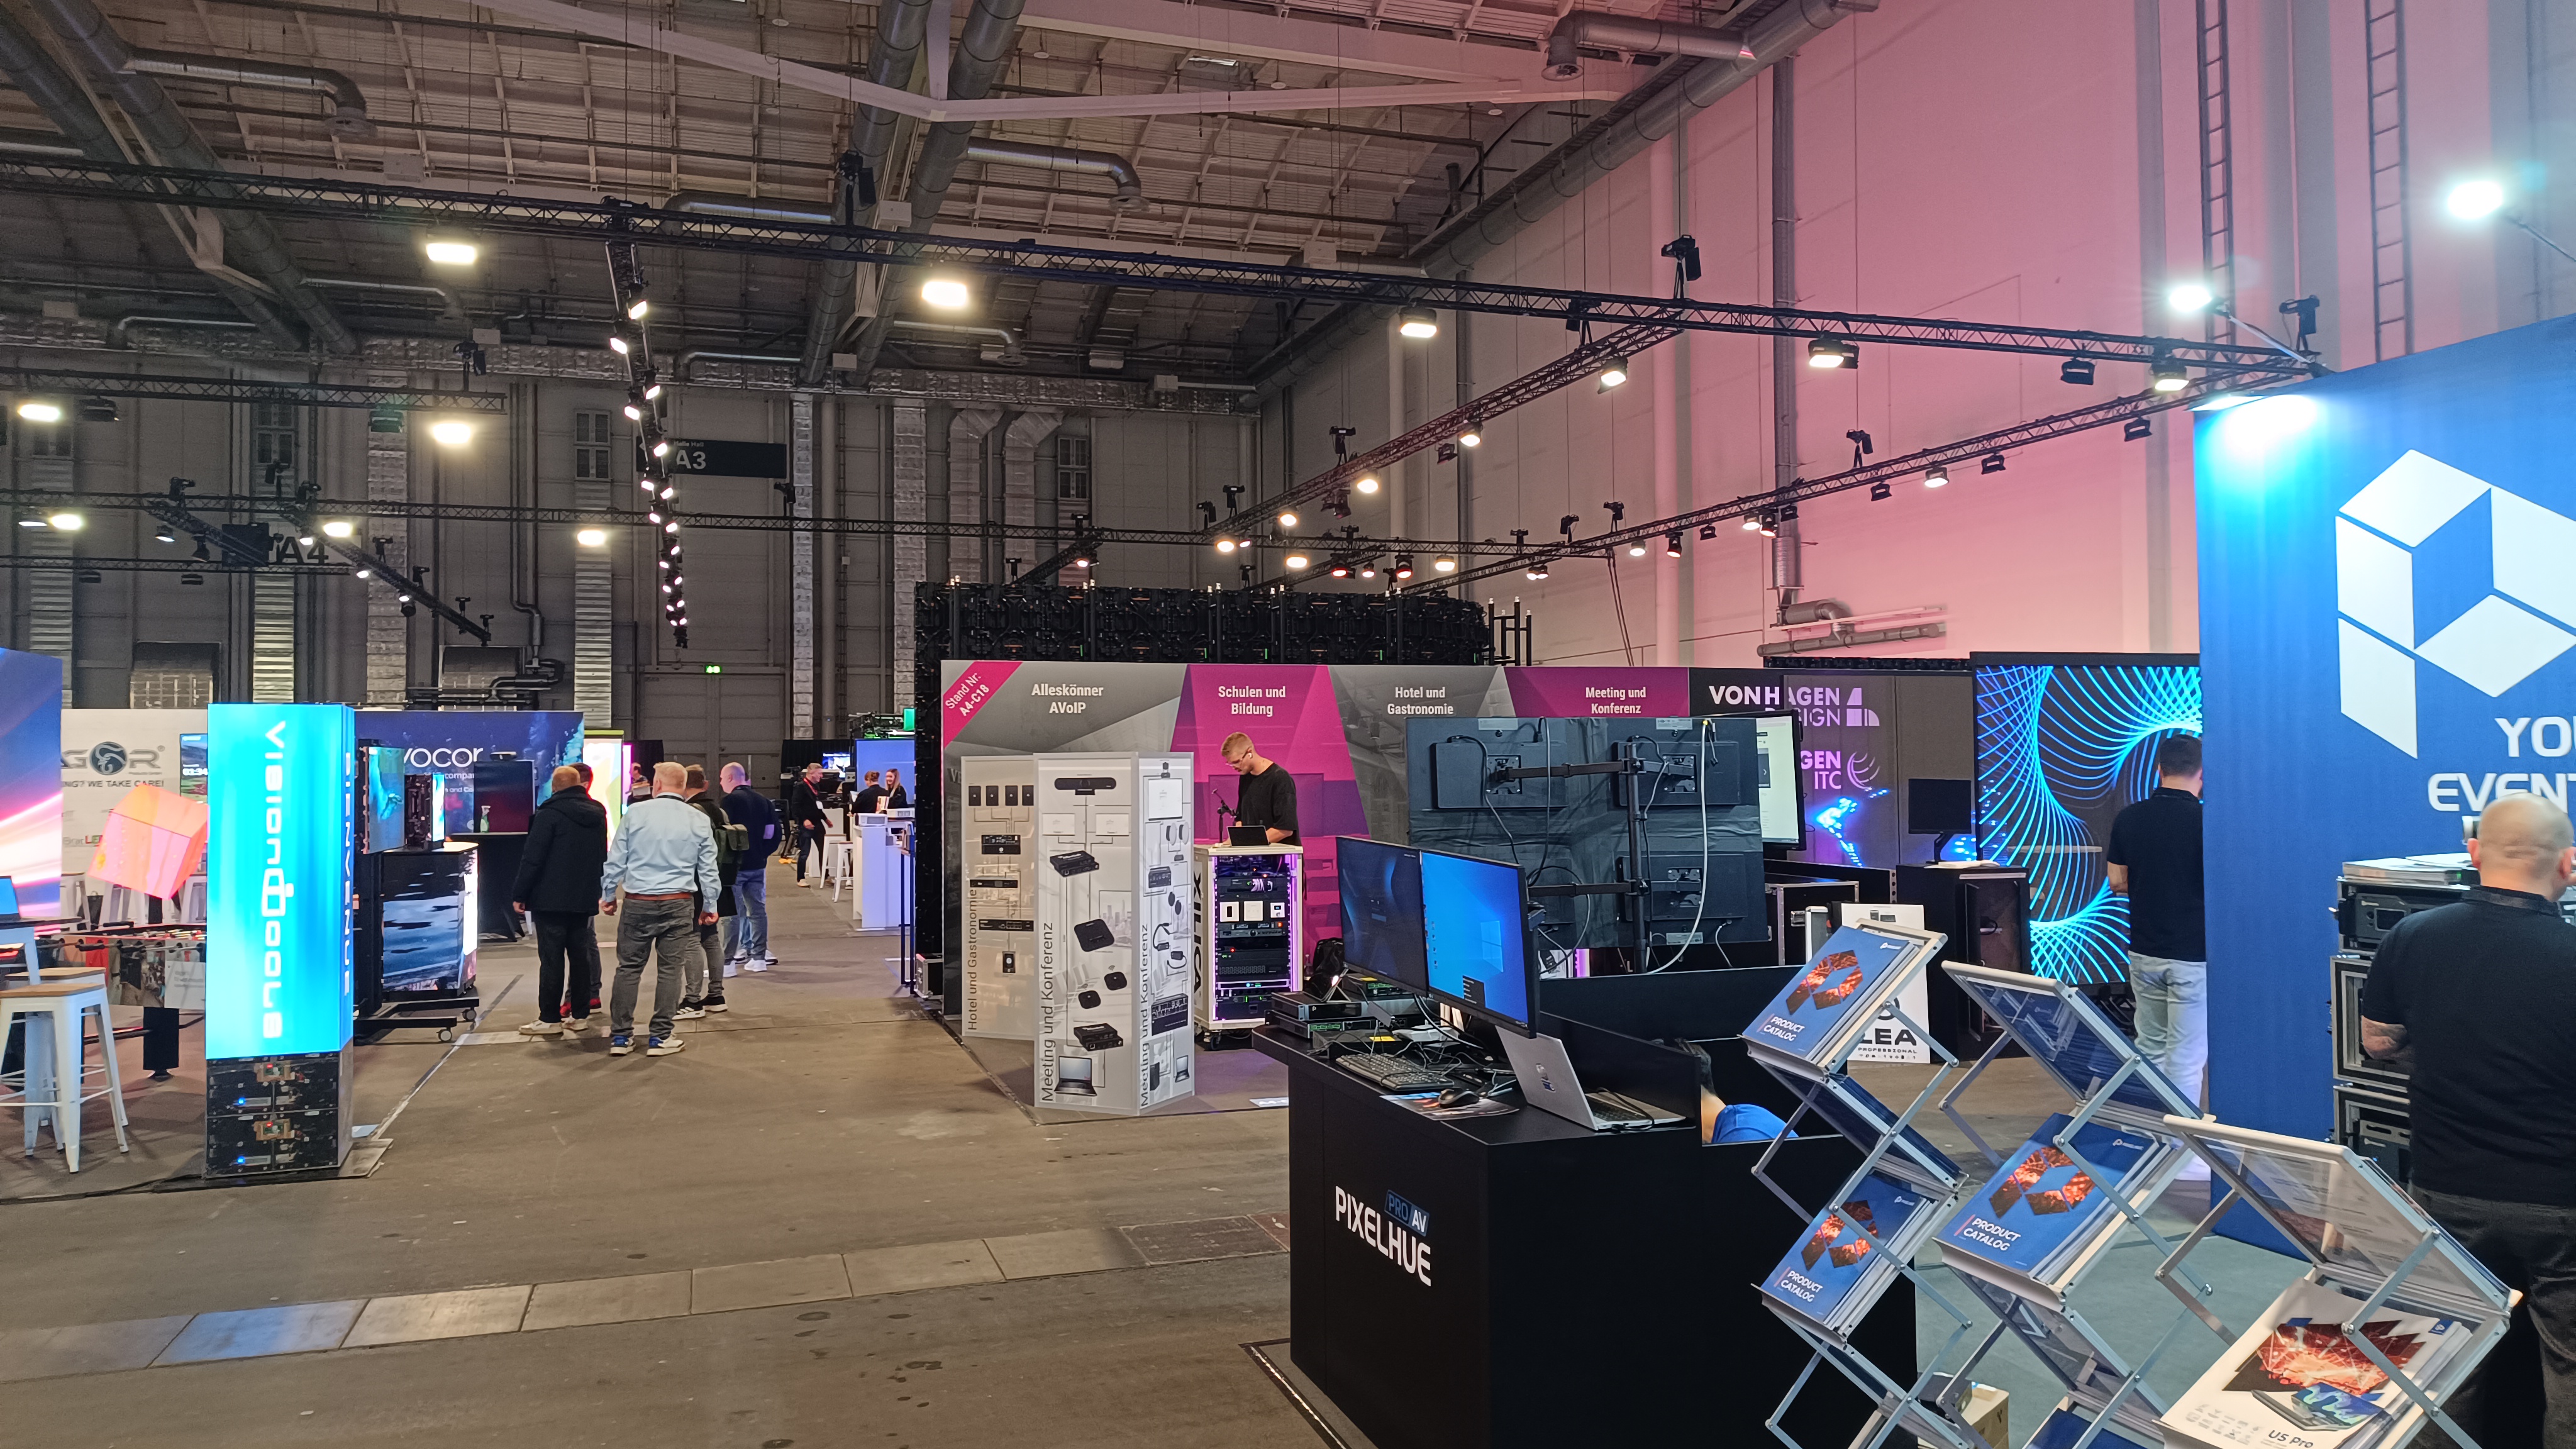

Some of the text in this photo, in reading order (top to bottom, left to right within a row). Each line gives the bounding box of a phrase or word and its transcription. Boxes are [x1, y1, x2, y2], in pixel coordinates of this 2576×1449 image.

[676, 450, 706, 470] A3
[279, 536, 329, 564] A4
[945, 684, 970, 709] Stand
[1031, 683, 1104, 696] Alleskönner
[1218, 686, 1286, 697] Schulen und
[1395, 687, 1446, 698] Hotel und
[1585, 687, 1646, 701] Meeting und
[1709, 686, 1761, 705] VON
[959, 684, 990, 716] A4-C18
[1049, 702, 1086, 714] AVoIP
[1231, 702, 1273, 717] Bildung
[1387, 703, 1454, 714] Gastronomie
[1591, 702, 1641, 714] Konferenz
[2494, 716, 2576, 757] YO
[1801, 750, 1841, 769] GEN
[1814, 771, 1841, 789] ITC
[2428, 773, 2576, 814] EVEN
[967, 889, 977, 1030] Hotel und Gastronomie
[1041, 923, 1056, 1101] Meeting und Konferenz
[1140, 923, 1150, 1107] Meeting und Konferenz
[1763, 1024, 1797, 1041] CATALOG
[1771, 1016, 1805, 1033] PRODUCT
[1388, 1194, 1427, 1233] PRO AV
[1335, 1185, 1431, 1287] PIXELHUE
[1963, 1228, 2011, 1251] CATALOG
[1972, 1218, 2021, 1241] PRODUCT
[1781, 1280, 1815, 1302] CATALOG
[1787, 1270, 1823, 1293] PRODUCT
[2289, 1436, 2314, 1448] Pro
